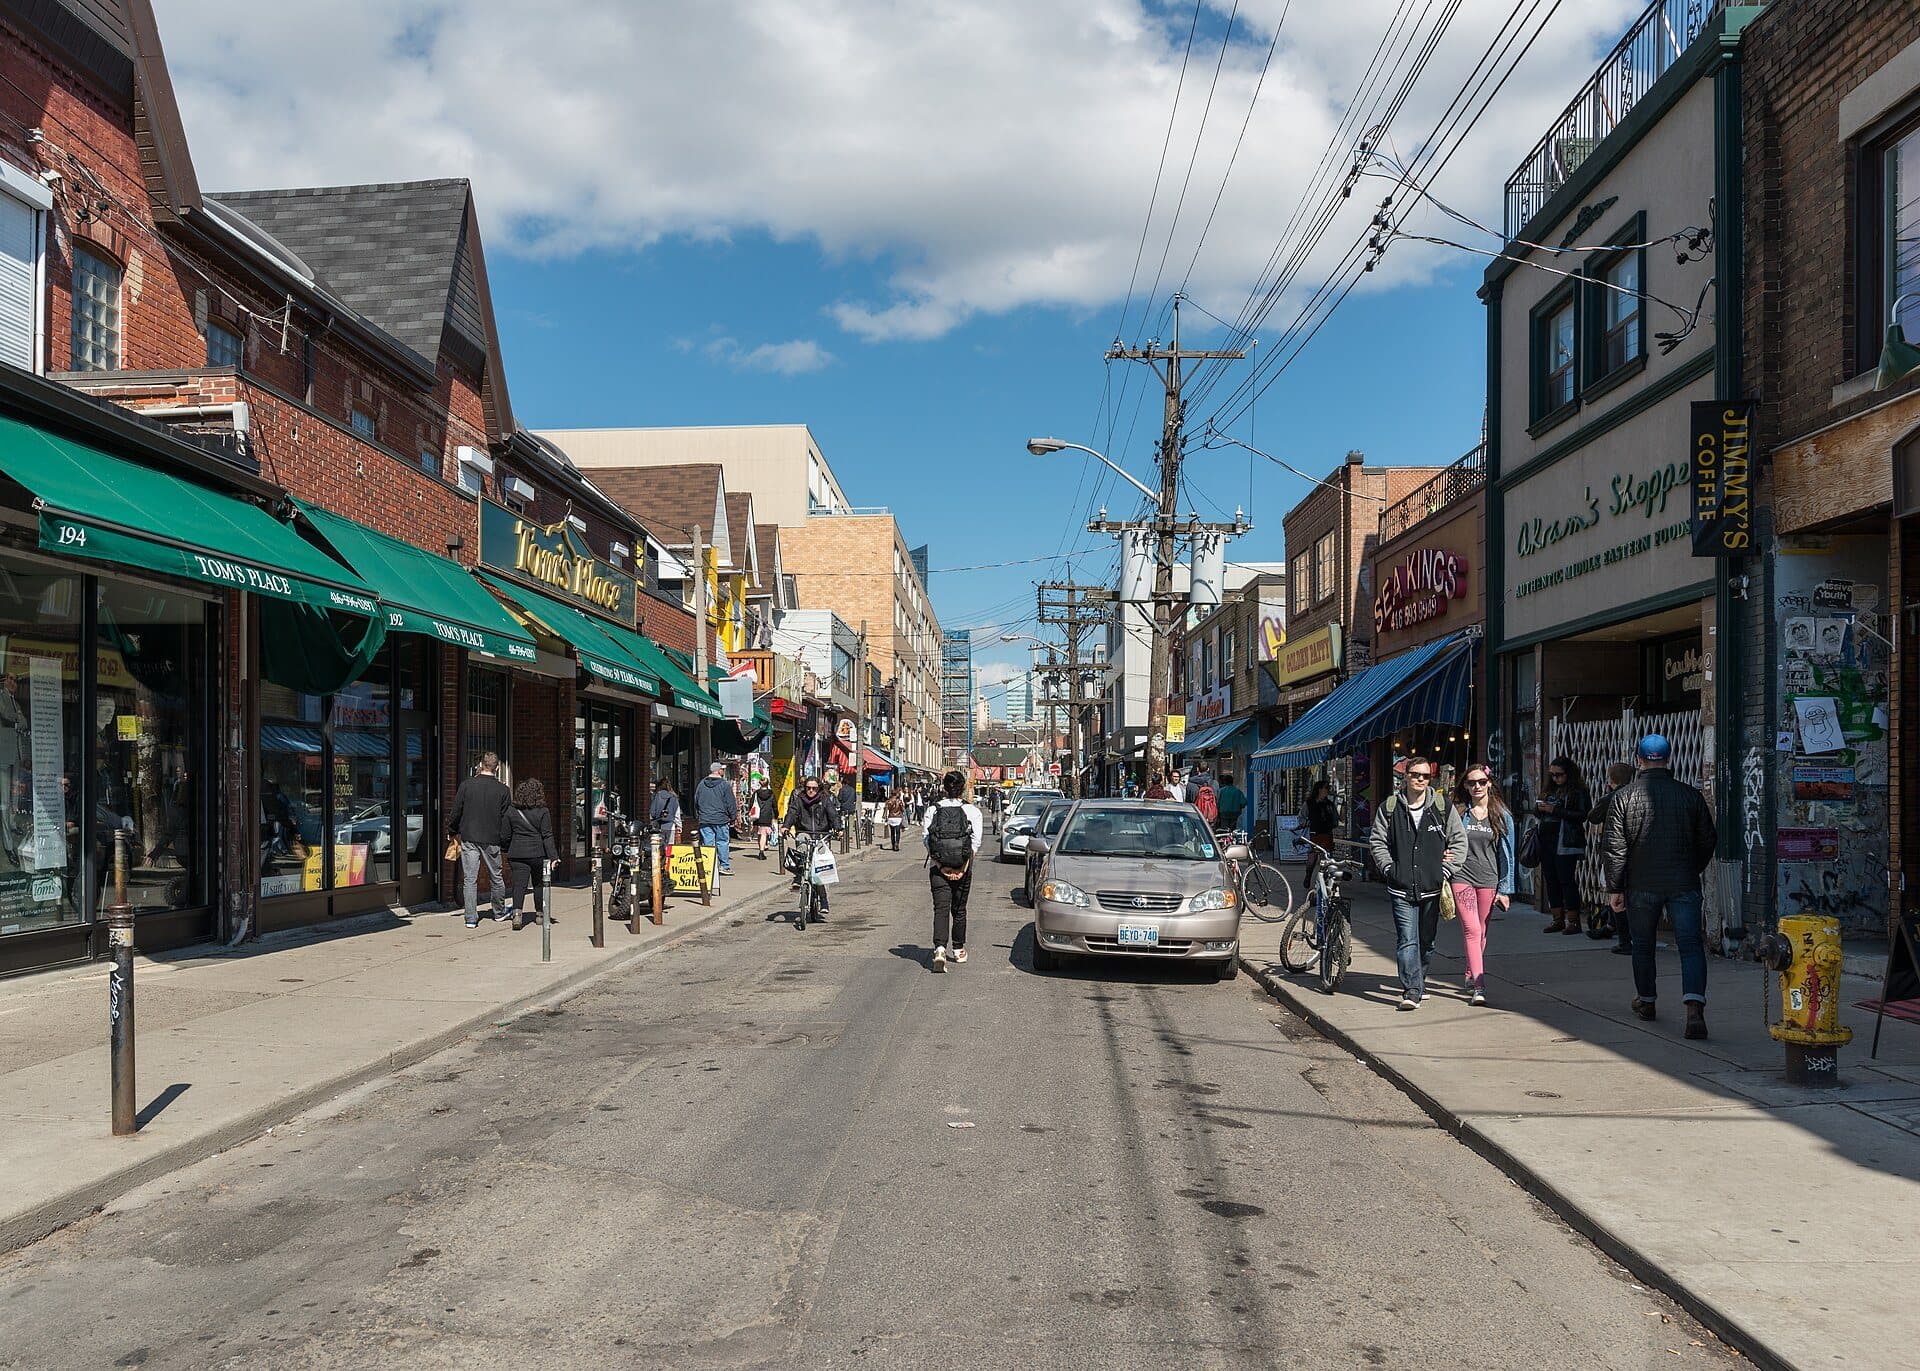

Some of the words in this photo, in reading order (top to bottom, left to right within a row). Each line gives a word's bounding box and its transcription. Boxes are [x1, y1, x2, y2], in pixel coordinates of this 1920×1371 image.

[1608, 462, 1691, 519] Shoppe
[1697, 433, 1716, 521] COFFEE
[1722, 409, 1749, 549] JIMMY'S
[57, 525, 87, 547] 194
[1514, 569, 1564, 599] AUTHENTIC
[1564, 552, 1601, 580] MIDDLE
[1602, 533, 1651, 566] EASTERN
[1653, 518, 1692, 547] FOODS
[194, 555, 246, 584] TOM'S
[246, 567, 292, 595] PLACE
[513, 520, 571, 591] Tom's
[571, 554, 621, 612] Place
[1374, 565, 1403, 633] SEA
[1406, 548, 1458, 600] KINGS
[389, 613, 404, 626] 192
[432, 620, 461, 641] TOM'S
[459, 628, 485, 648] PLACE
[1286, 646, 1309, 674] GOLDEN
[1309, 636, 1330, 666] PATTY
[1142, 930, 1158, 942] 740
